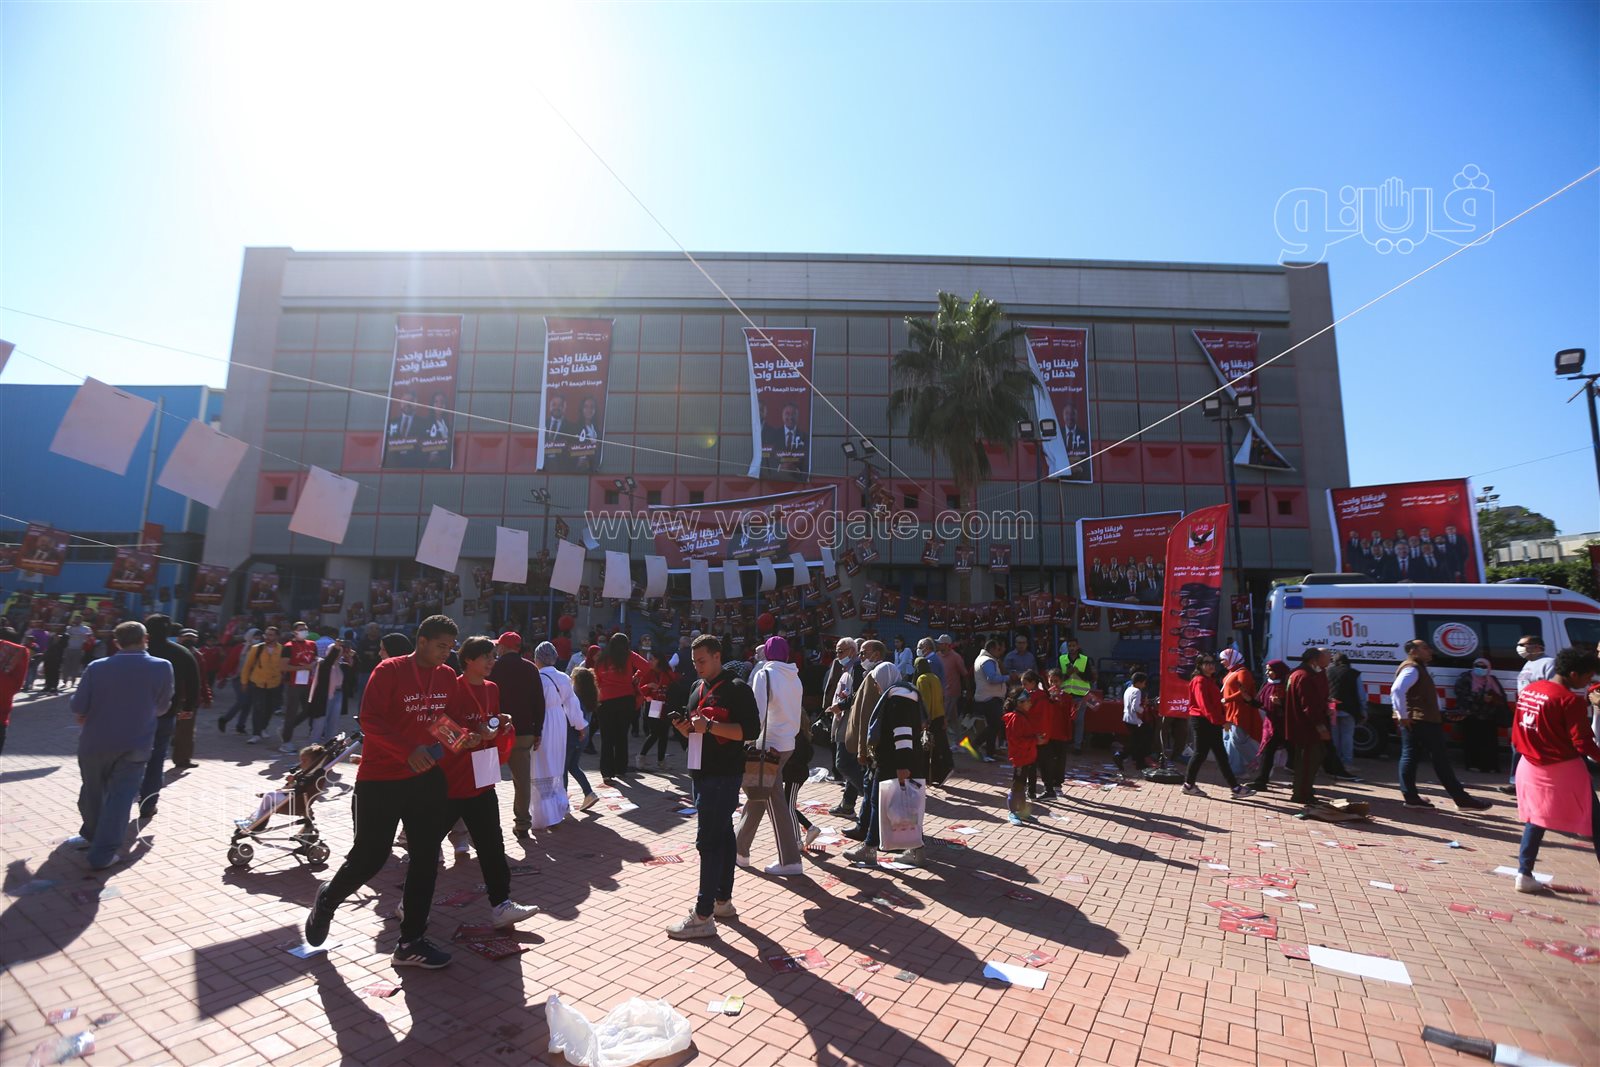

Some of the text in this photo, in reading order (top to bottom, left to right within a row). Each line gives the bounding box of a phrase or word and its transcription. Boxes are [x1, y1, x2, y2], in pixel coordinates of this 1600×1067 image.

[574, 351, 603, 364] فريقنا
[399, 359, 448, 373] هدفنا واحد
[776, 359, 804, 371] فريقنا
[1053, 358, 1080, 370] فريقنا
[548, 363, 598, 377] هدفنا واحد
[773, 370, 801, 379] هدفنا
[1051, 369, 1076, 379] هدفنا
[1360, 502, 1385, 511] هدفنا
[1104, 524, 1124, 534] فريقنا
[1089, 532, 1121, 543] هدفنا واحد
[679, 539, 720, 553] هدفنا واحد
[1326, 619, 1368, 638] 16010
[1330, 640, 1353, 648] مصر
[1355, 639, 1400, 649] مستشفى
[1366, 650, 1397, 660] HOSPITAL
[403, 693, 420, 703] الدين
[1170, 704, 1188, 713] واحد
